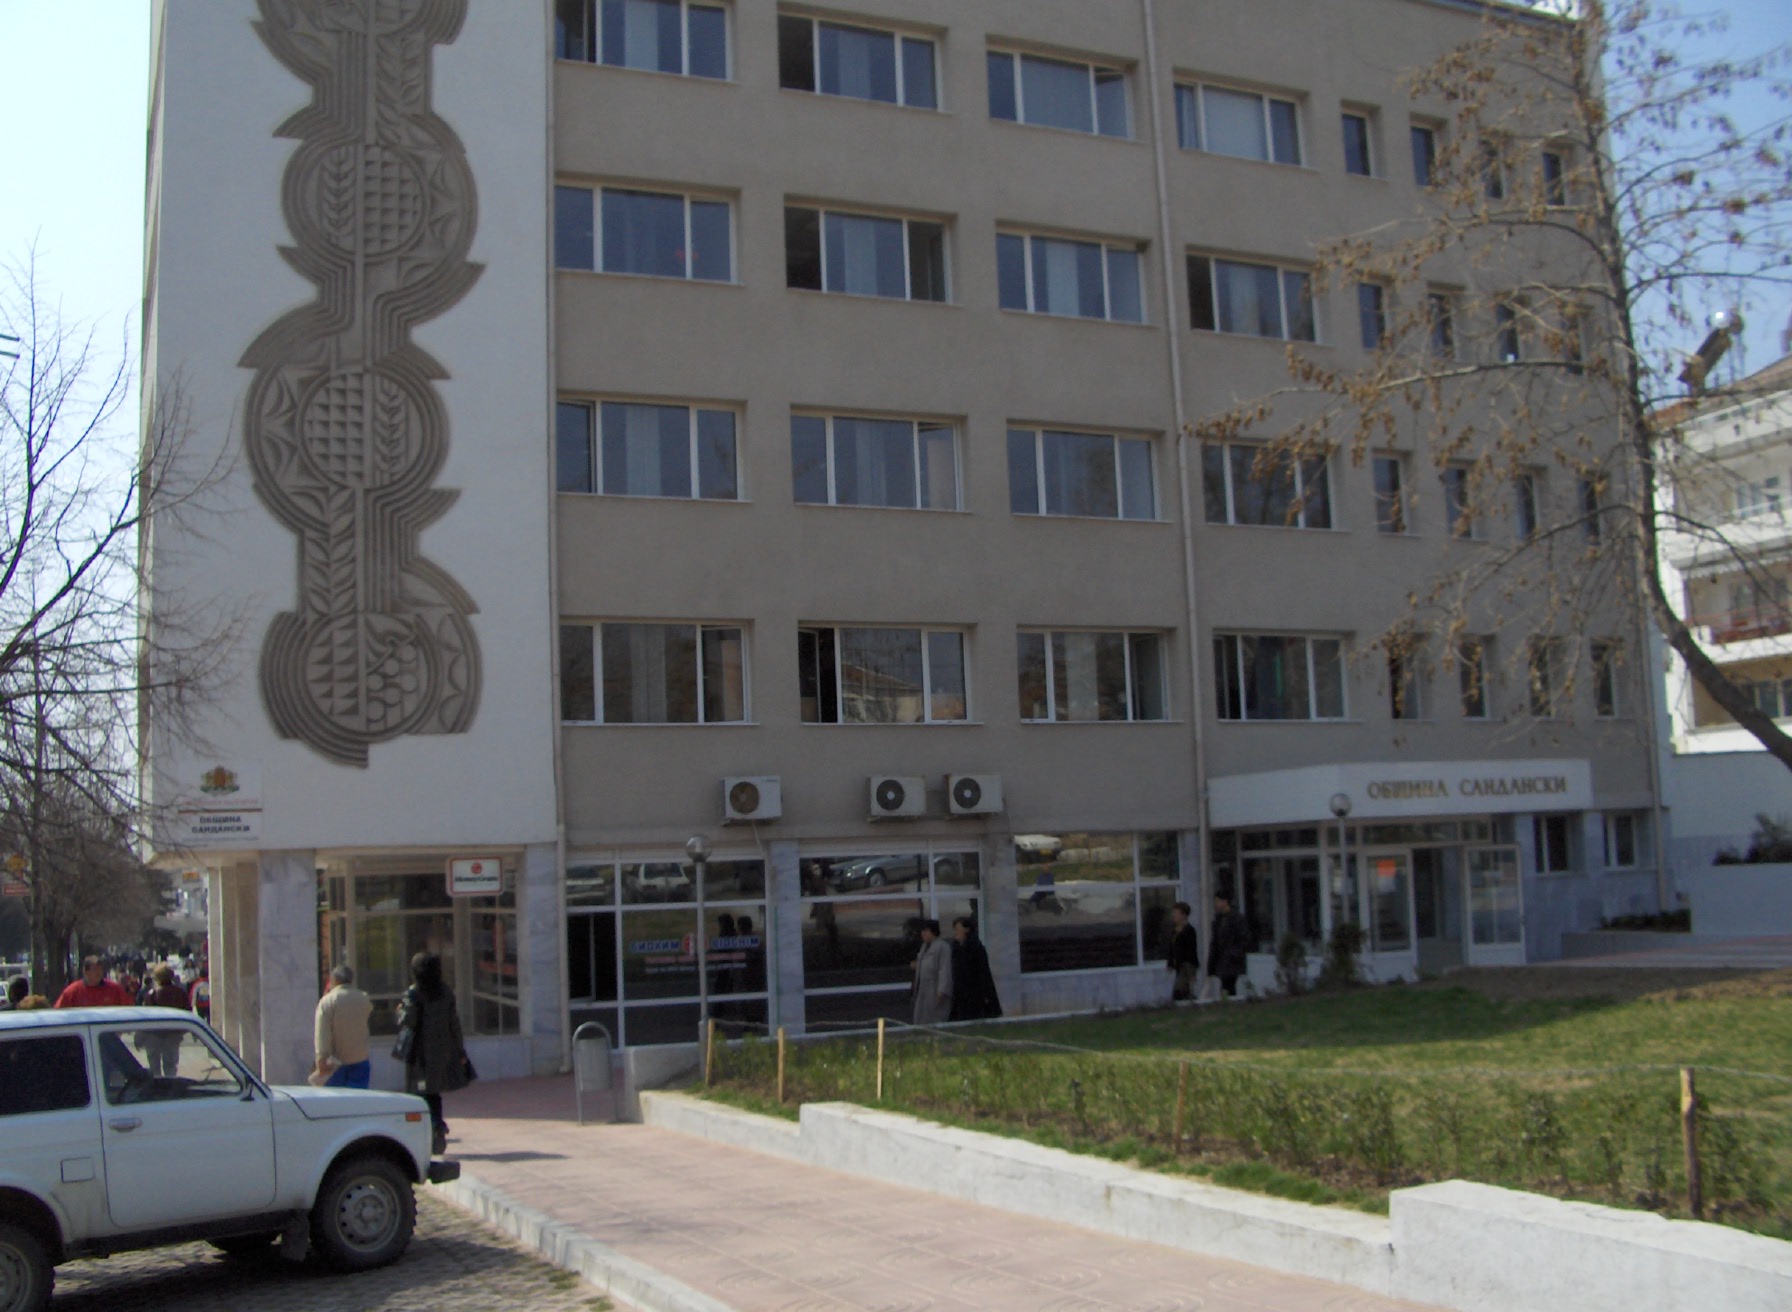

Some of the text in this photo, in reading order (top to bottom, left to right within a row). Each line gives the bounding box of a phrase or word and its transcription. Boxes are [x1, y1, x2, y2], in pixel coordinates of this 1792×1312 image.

[1367, 776, 1566, 798] ОБЩИНА САНДАНСКИ
[199, 815, 242, 824] ОБЩИНА
